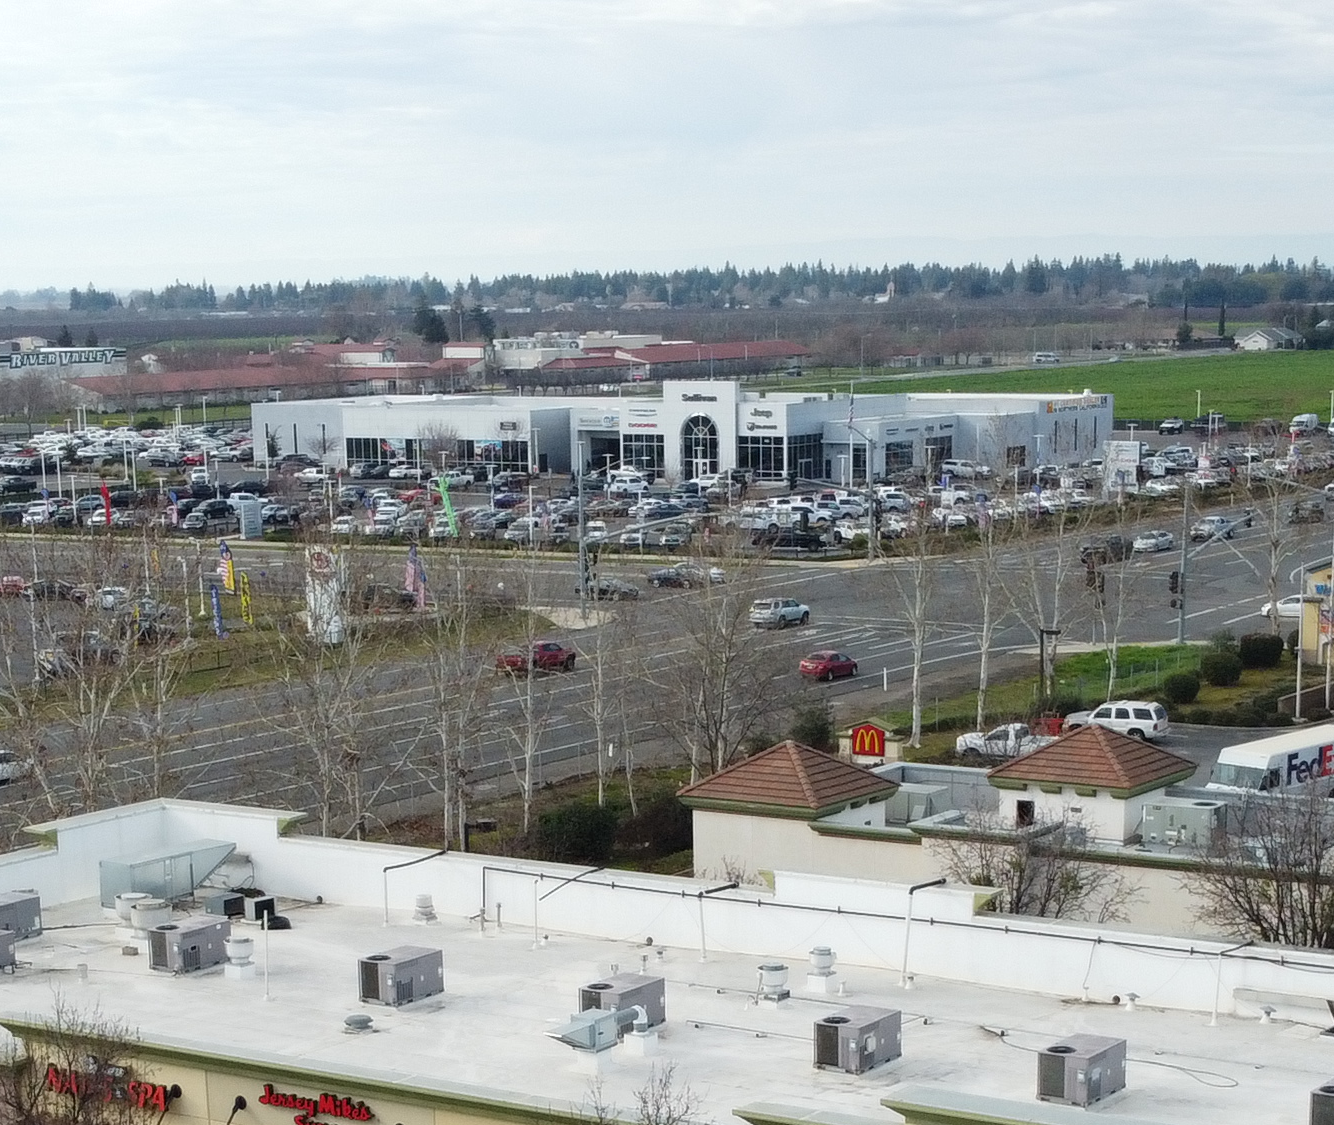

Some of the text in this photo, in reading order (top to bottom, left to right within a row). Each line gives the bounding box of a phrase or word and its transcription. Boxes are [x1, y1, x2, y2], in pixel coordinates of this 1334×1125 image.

[10, 349, 115, 368] RIVER VALLEY
[48, 1066, 113, 1102] NAS
[128, 1080, 166, 1112] SPA
[259, 1085, 315, 1117] Jersey
